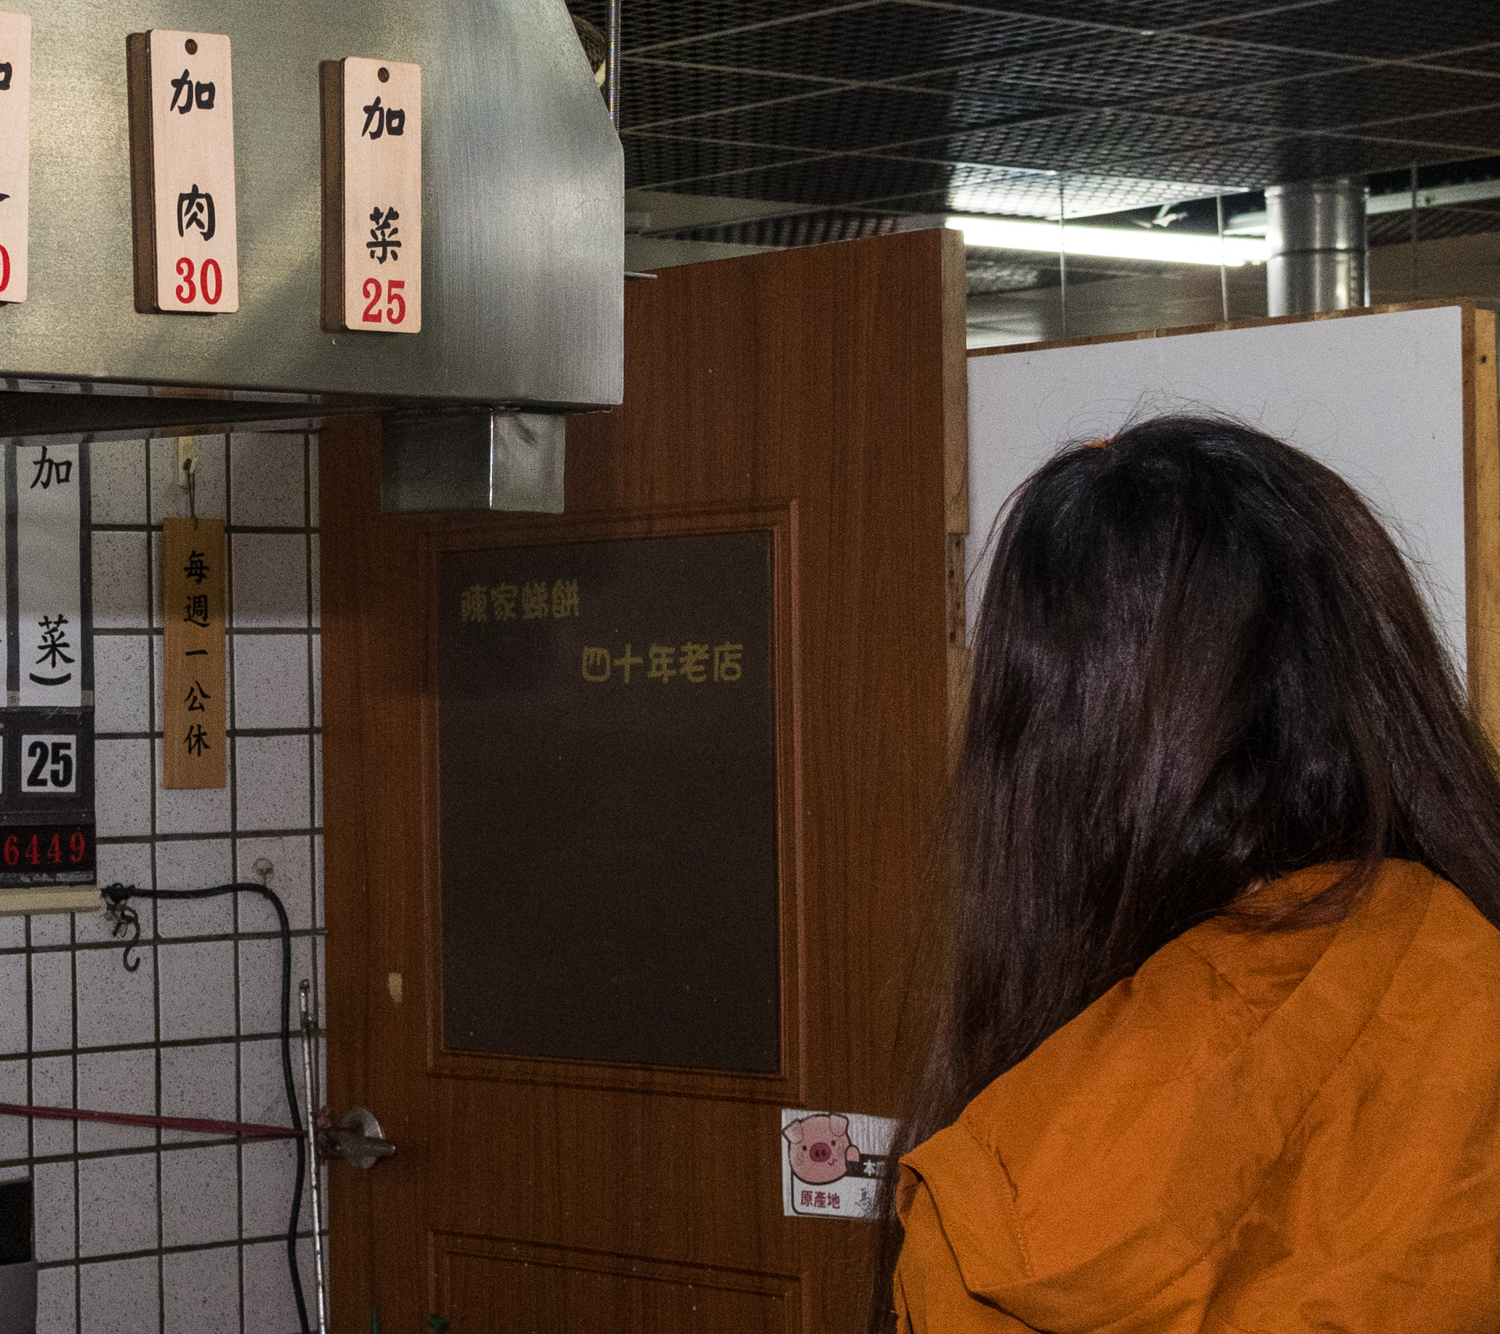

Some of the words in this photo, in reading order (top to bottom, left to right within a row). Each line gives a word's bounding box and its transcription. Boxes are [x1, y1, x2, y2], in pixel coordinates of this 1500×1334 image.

[174, 257, 223, 306] 30
[362, 278, 406, 324] 25
[183, 548, 210, 759] 每週一公休
[581, 641, 744, 685] 四十年老店
[27, 739, 75, 789] 25
[800, 1189, 841, 1210] 原產地
